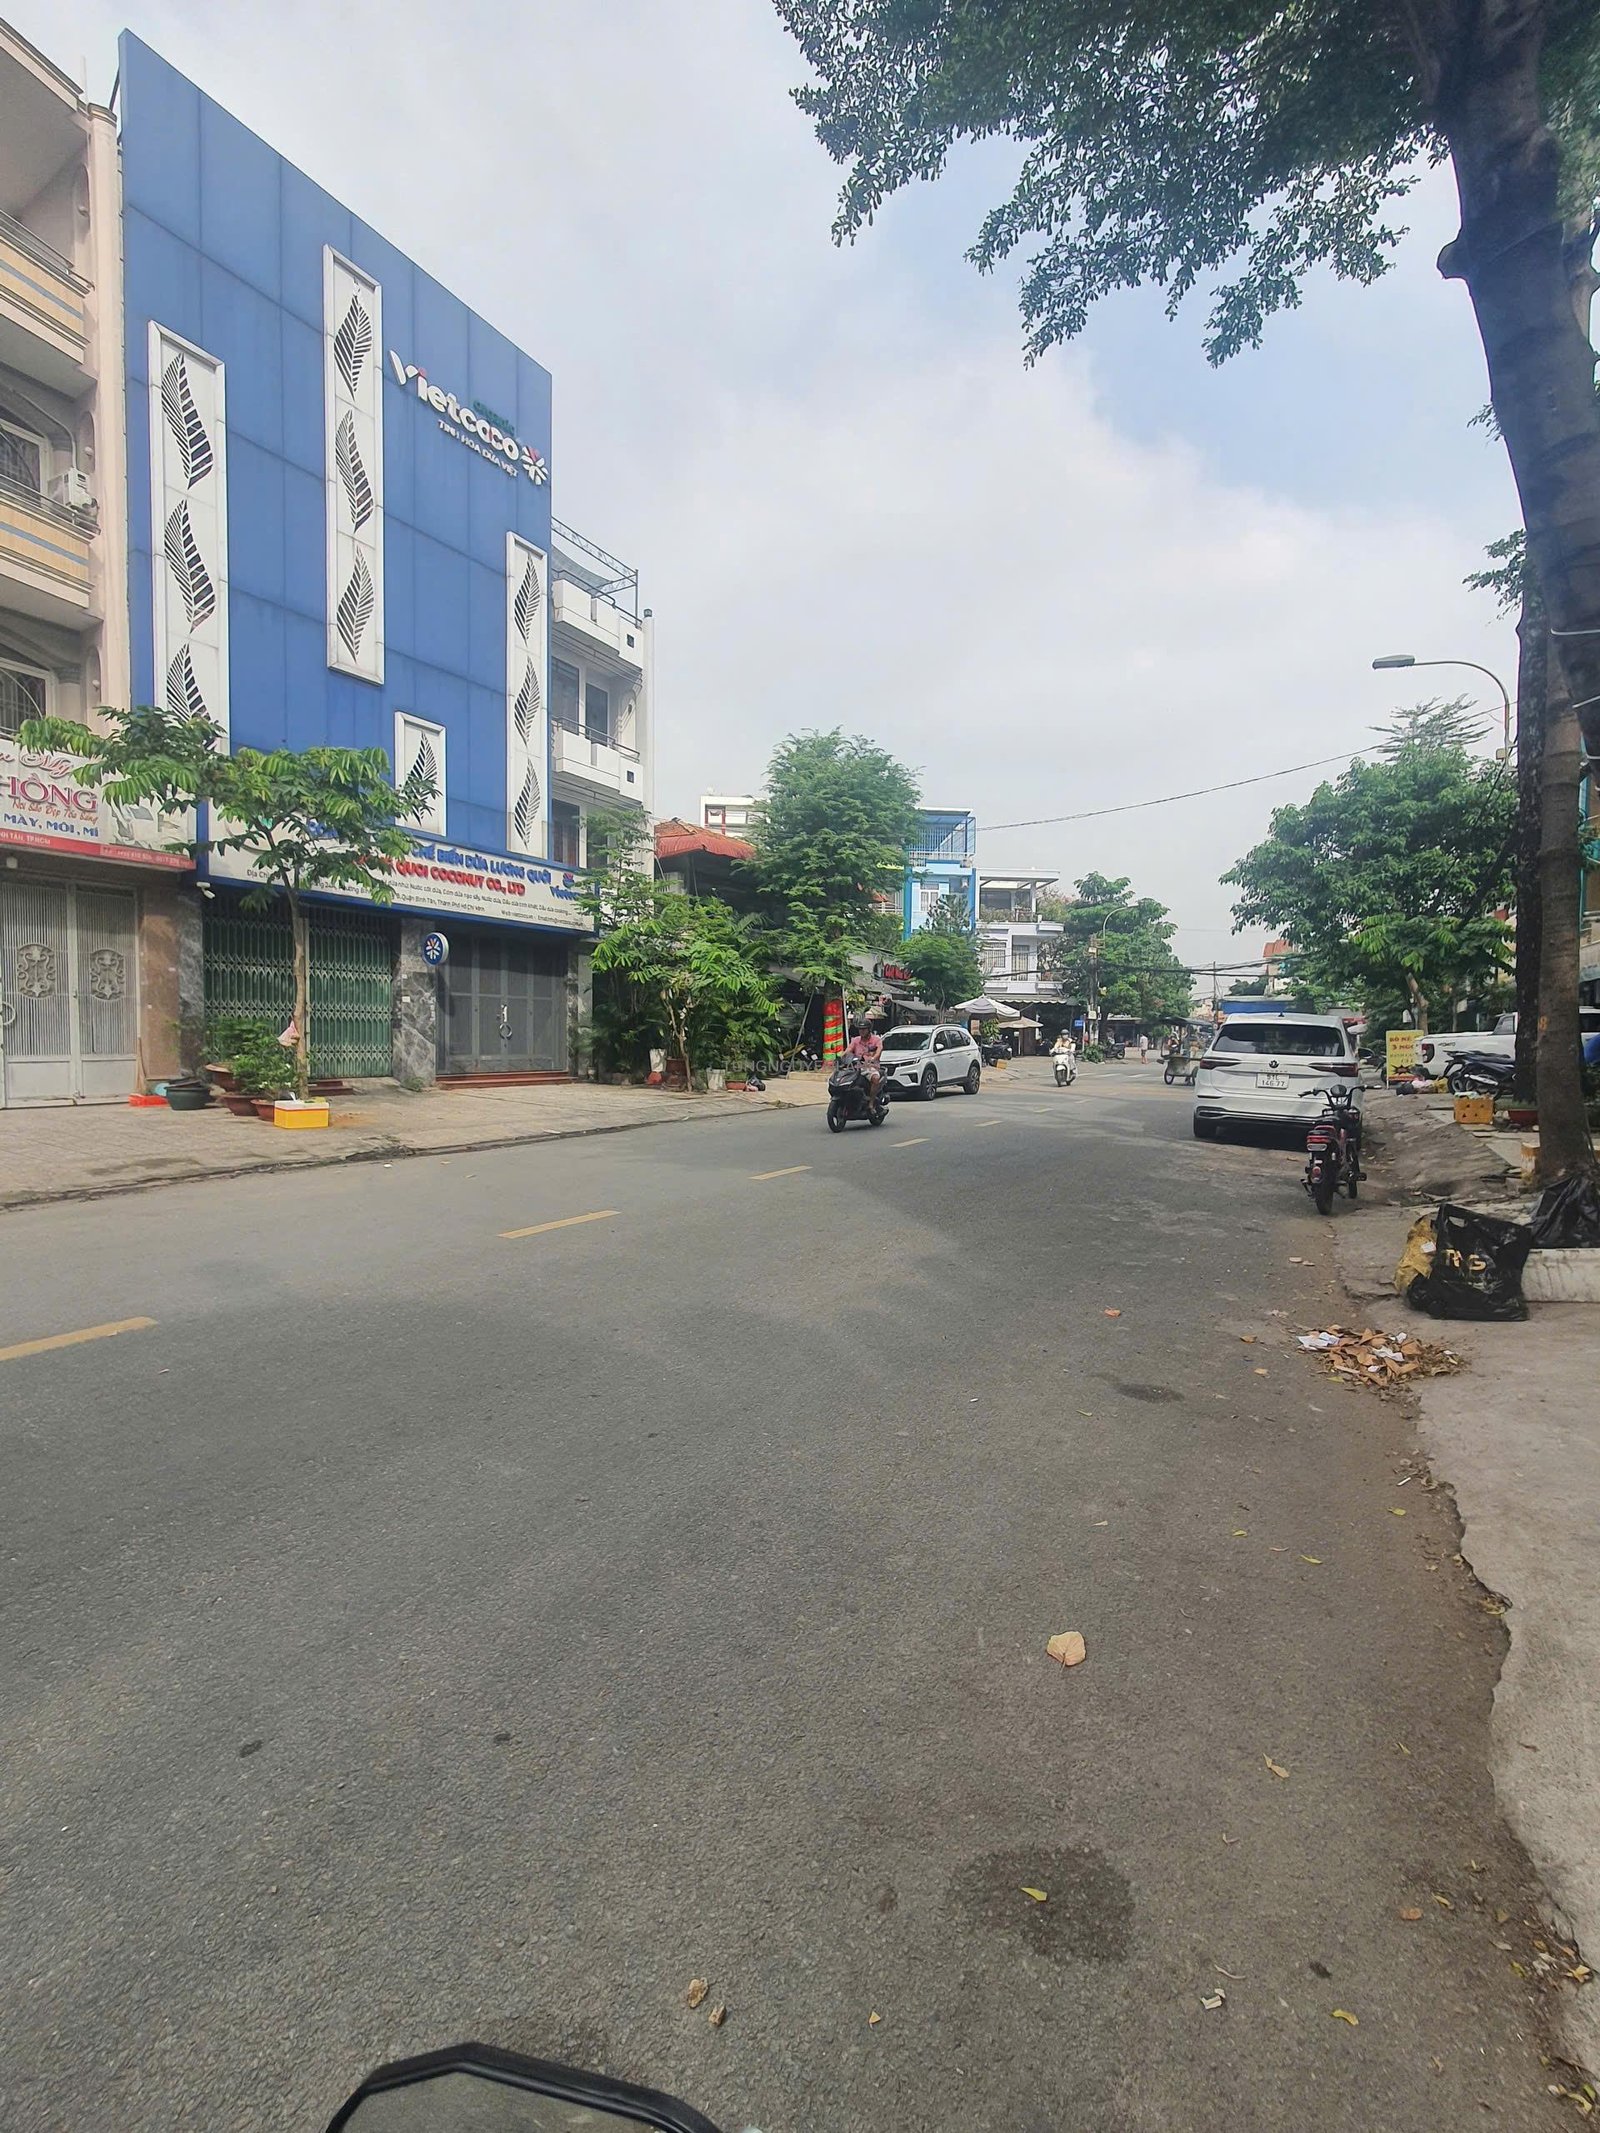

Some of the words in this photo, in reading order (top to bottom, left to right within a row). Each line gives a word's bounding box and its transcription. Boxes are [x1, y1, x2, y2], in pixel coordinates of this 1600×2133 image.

[389, 349, 519, 461] Vietcoco
[430, 866, 485, 889] COCONUT
[507, 881, 526, 896] LTD
